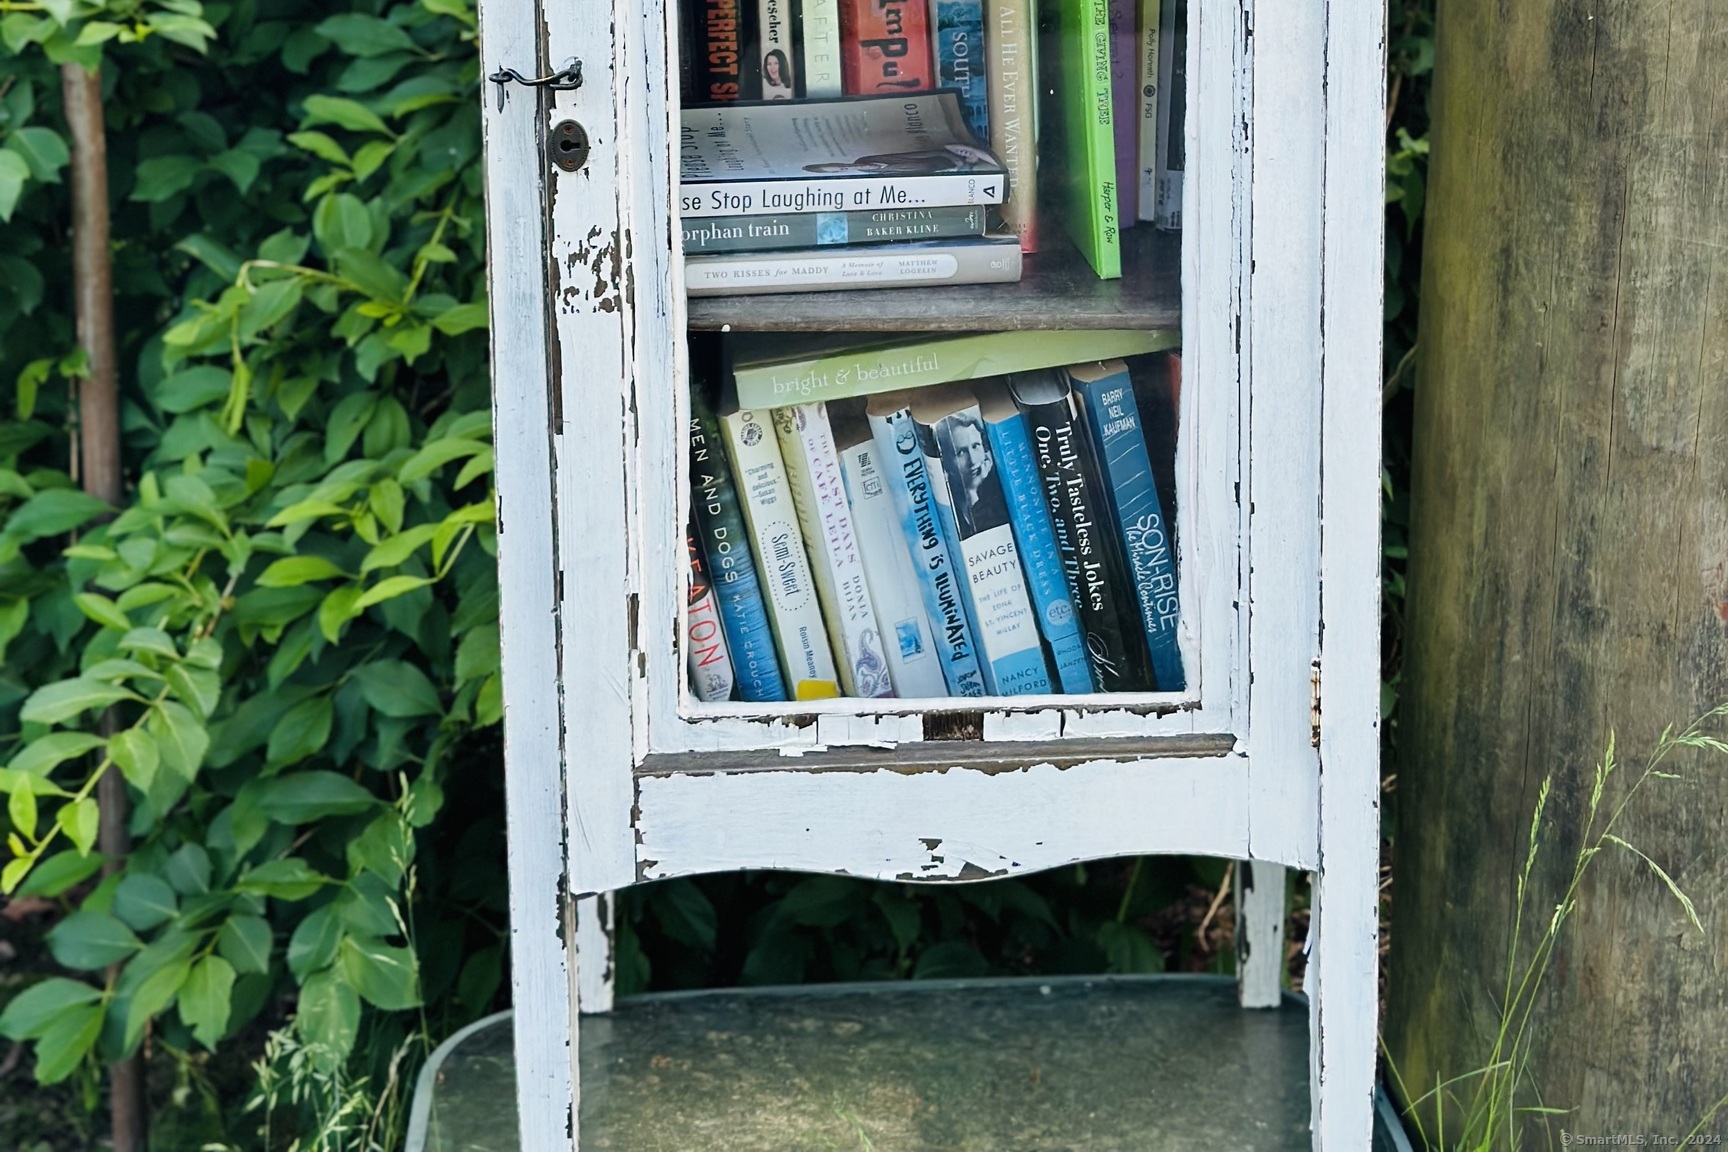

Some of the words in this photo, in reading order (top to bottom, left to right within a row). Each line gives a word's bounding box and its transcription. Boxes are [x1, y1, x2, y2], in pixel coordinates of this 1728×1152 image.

[1000, 5, 1016, 38] ALL
[1094, 0, 1106, 26] THE
[1147, 28, 1156, 47] Polly
[1001, 41, 1018, 66] HE
[1094, 32, 1109, 83] GIVING
[1146, 48, 1155, 79] Horvath
[1002, 70, 1019, 114] EVER
[1096, 87, 1111, 126] TREE
[1144, 102, 1153, 119] FSG
[1004, 117, 1021, 189] WANTED
[711, 190, 752, 213] Stop
[762, 186, 845, 212] Laughing
[854, 188, 871, 205] at
[879, 185, 926, 205] Me...
[967, 178, 976, 204] BLANCO
[1100, 181, 1114, 213] Harper
[872, 210, 933, 223] CHRISTINA
[1104, 215, 1114, 224] &
[681, 222, 743, 247] orphan
[748, 218, 790, 238] train
[866, 226, 903, 237] BAKER
[906, 223, 940, 234] KLINE
[1106, 226, 1117, 245] Row
[704, 271, 729, 280] TWO
[733, 269, 771, 278] KISSES
[773, 268, 789, 278] for
[791, 266, 831, 276] MADDY
[898, 259, 939, 267] MATTHEW
[899, 267, 937, 275] LOGELIN
[771, 372, 829, 396] bright
[835, 368, 851, 385] &
[856, 353, 940, 382] beautiful
[1101, 387, 1124, 406] BARRY
[1108, 405, 1125, 420] NEIL
[1103, 416, 1136, 437] KAUFMAN
[1055, 421, 1079, 472] Truly
[757, 471, 768, 481] and
[1035, 426, 1053, 469] One,
[1055, 518, 1075, 552] and
[826, 461, 844, 508] LAST
[839, 516, 857, 564] DAYS
[1066, 472, 1092, 556] Tasteless
[826, 513, 844, 568] LEILA
[1018, 493, 1038, 542] BLACK
[1032, 549, 1052, 596] DRESS
[1125, 524, 1142, 542] The
[690, 417, 709, 462] MEN
[701, 474, 722, 516] AND
[713, 526, 739, 584] DOGS
[732, 594, 750, 635] KATIE
[743, 640, 765, 698] CROUCH
[968, 542, 1015, 568] SAVAGE
[1044, 542, 1055, 560] IN
[771, 533, 802, 597] Semi-Sweet
[972, 559, 1018, 585] BEAUTY
[1137, 512, 1179, 632] SON-RISE
[852, 575, 869, 619] DONIA
[979, 592, 992, 604] THE
[994, 587, 1009, 598] LIFE
[1011, 583, 1022, 593] OF
[1083, 560, 1105, 612] Jokes
[842, 580, 857, 622] BIJAN
[992, 600, 1013, 612] EDNA
[1049, 603, 1072, 620] etc.
[995, 608, 1028, 624] VINCENT
[996, 622, 1022, 636] MILLAY
[798, 626, 810, 651] Roisin
[804, 649, 818, 679] Meaney
[1001, 666, 1039, 686] NANCY
